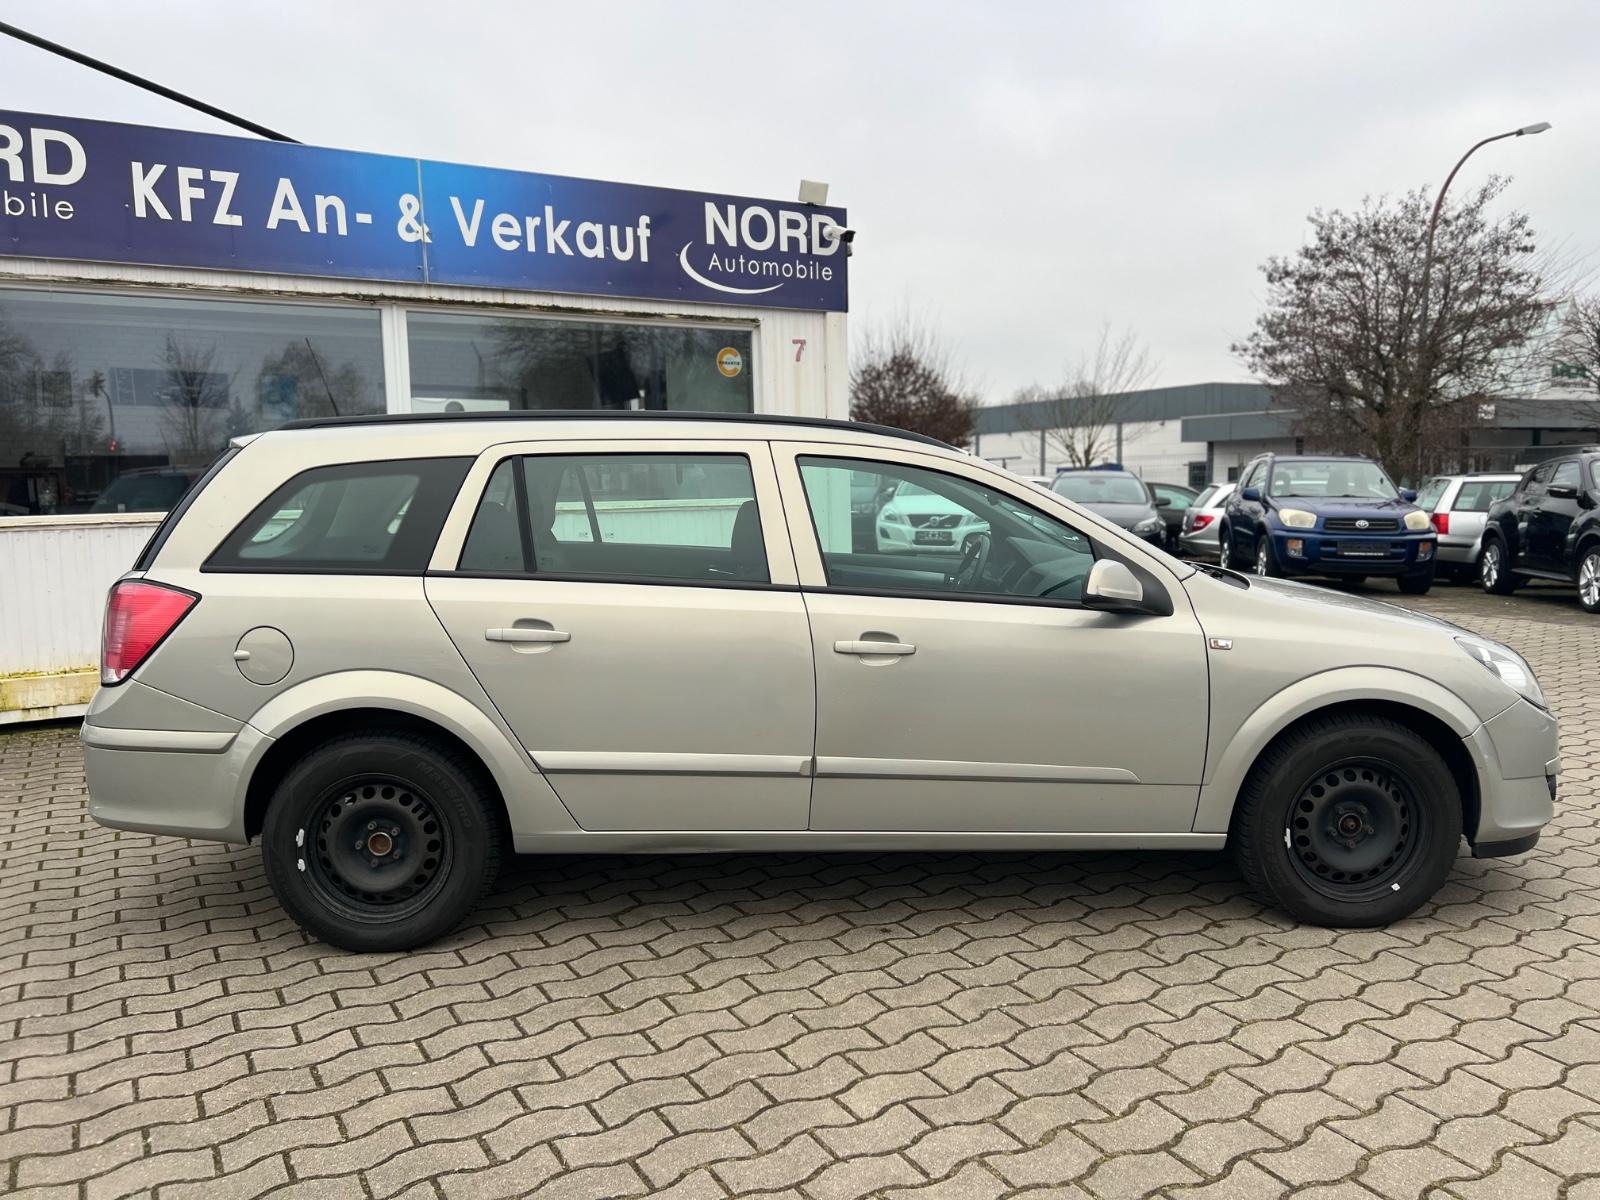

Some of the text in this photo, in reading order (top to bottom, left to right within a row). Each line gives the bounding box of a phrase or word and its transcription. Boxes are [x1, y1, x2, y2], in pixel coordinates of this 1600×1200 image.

[4, 190, 74, 220] bile
[131, 161, 651, 263] KFZ An- & Verkauf
[704, 201, 841, 256] NORD
[708, 252, 833, 281] Automobile
[791, 338, 807, 362] 7
